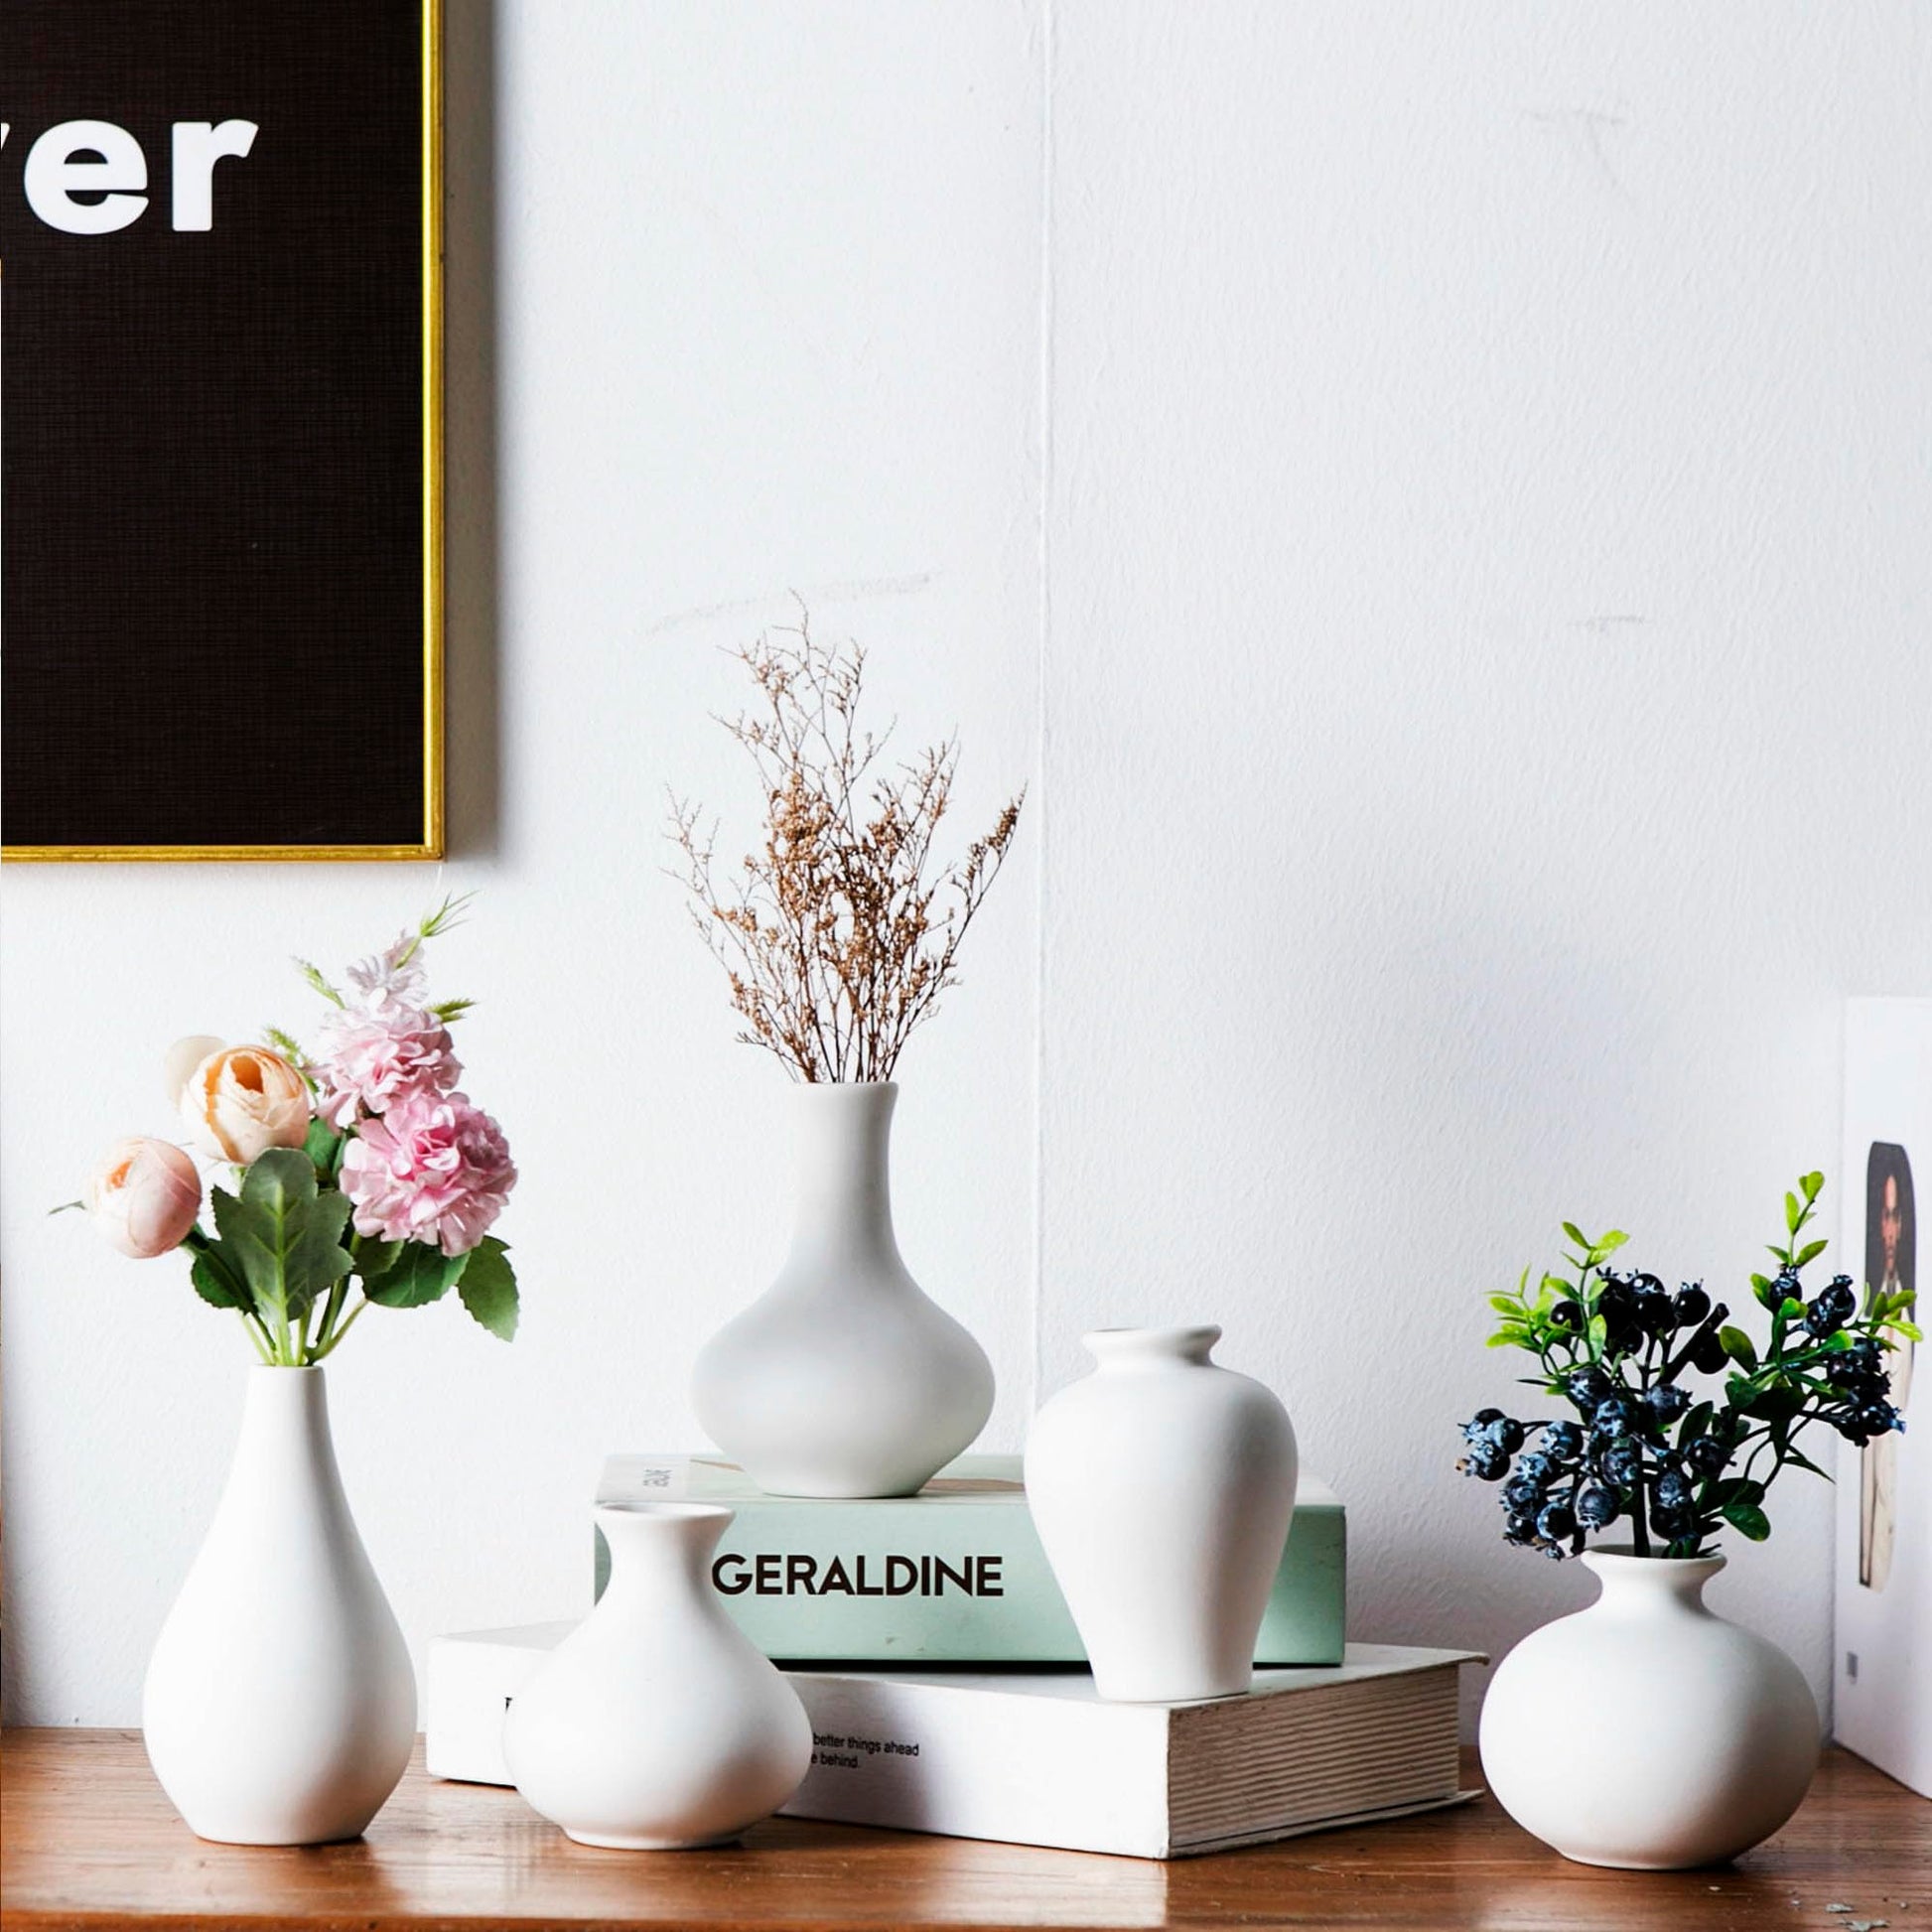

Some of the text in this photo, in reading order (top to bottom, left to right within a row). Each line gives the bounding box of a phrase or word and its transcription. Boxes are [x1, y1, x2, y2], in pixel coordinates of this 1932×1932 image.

[1, 118, 259, 234] er
[711, 1554, 1004, 1596] GERALDINE
[812, 1732, 919, 1756] better things ahead
